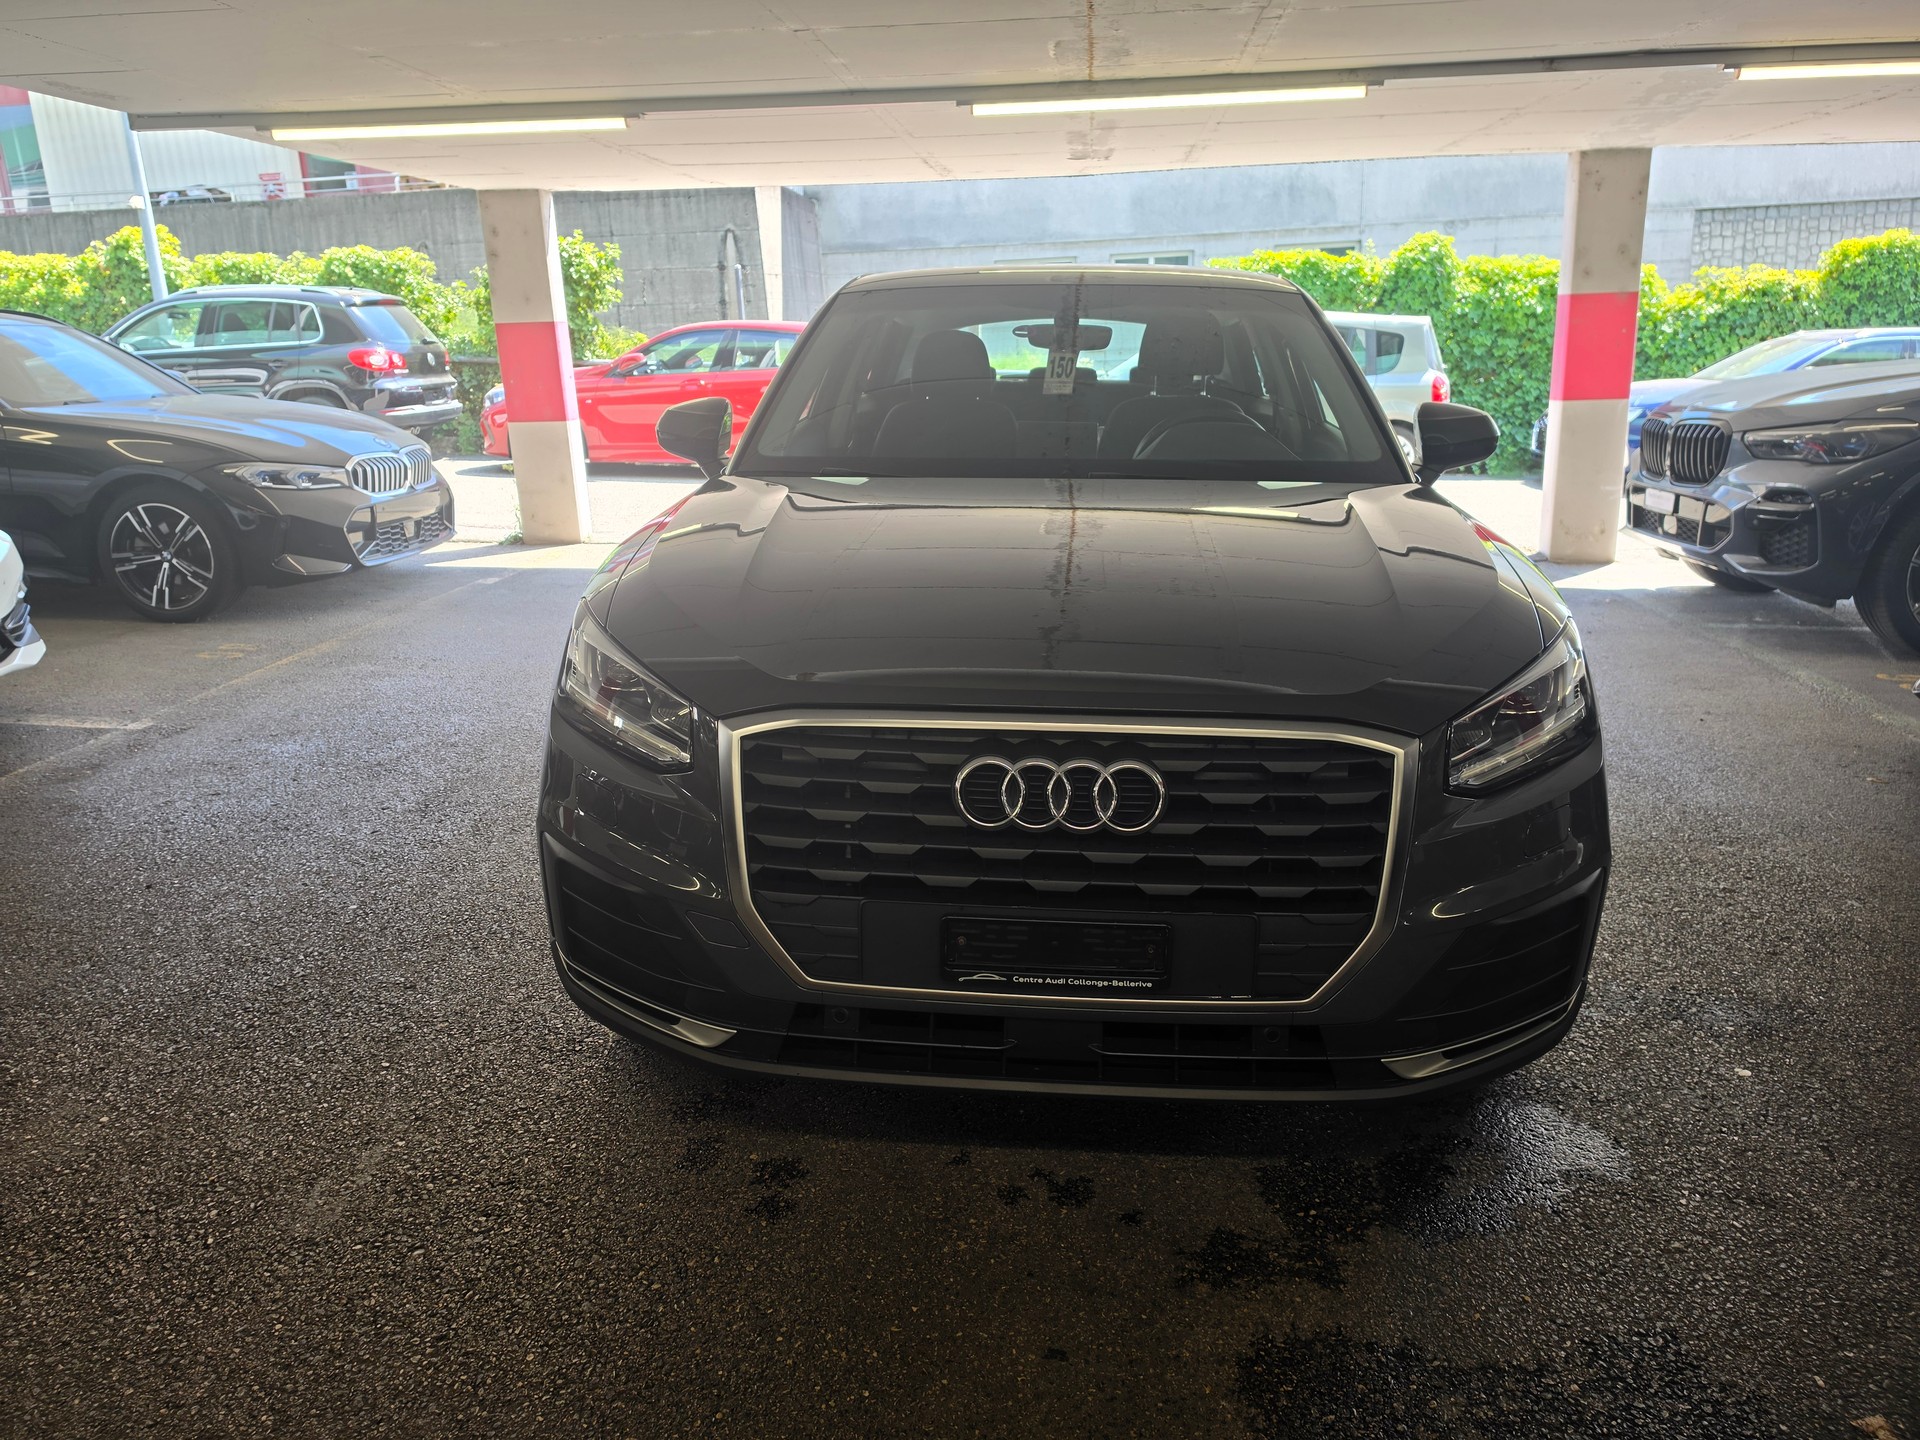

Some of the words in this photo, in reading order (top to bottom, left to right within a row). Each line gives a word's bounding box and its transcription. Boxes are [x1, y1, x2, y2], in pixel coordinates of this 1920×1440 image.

[1050, 356, 1074, 379] 150
[1013, 975, 1043, 984] Centre
[1045, 977, 1066, 985] Audi
[1068, 978, 1153, 988] Collonge-Bellerive
